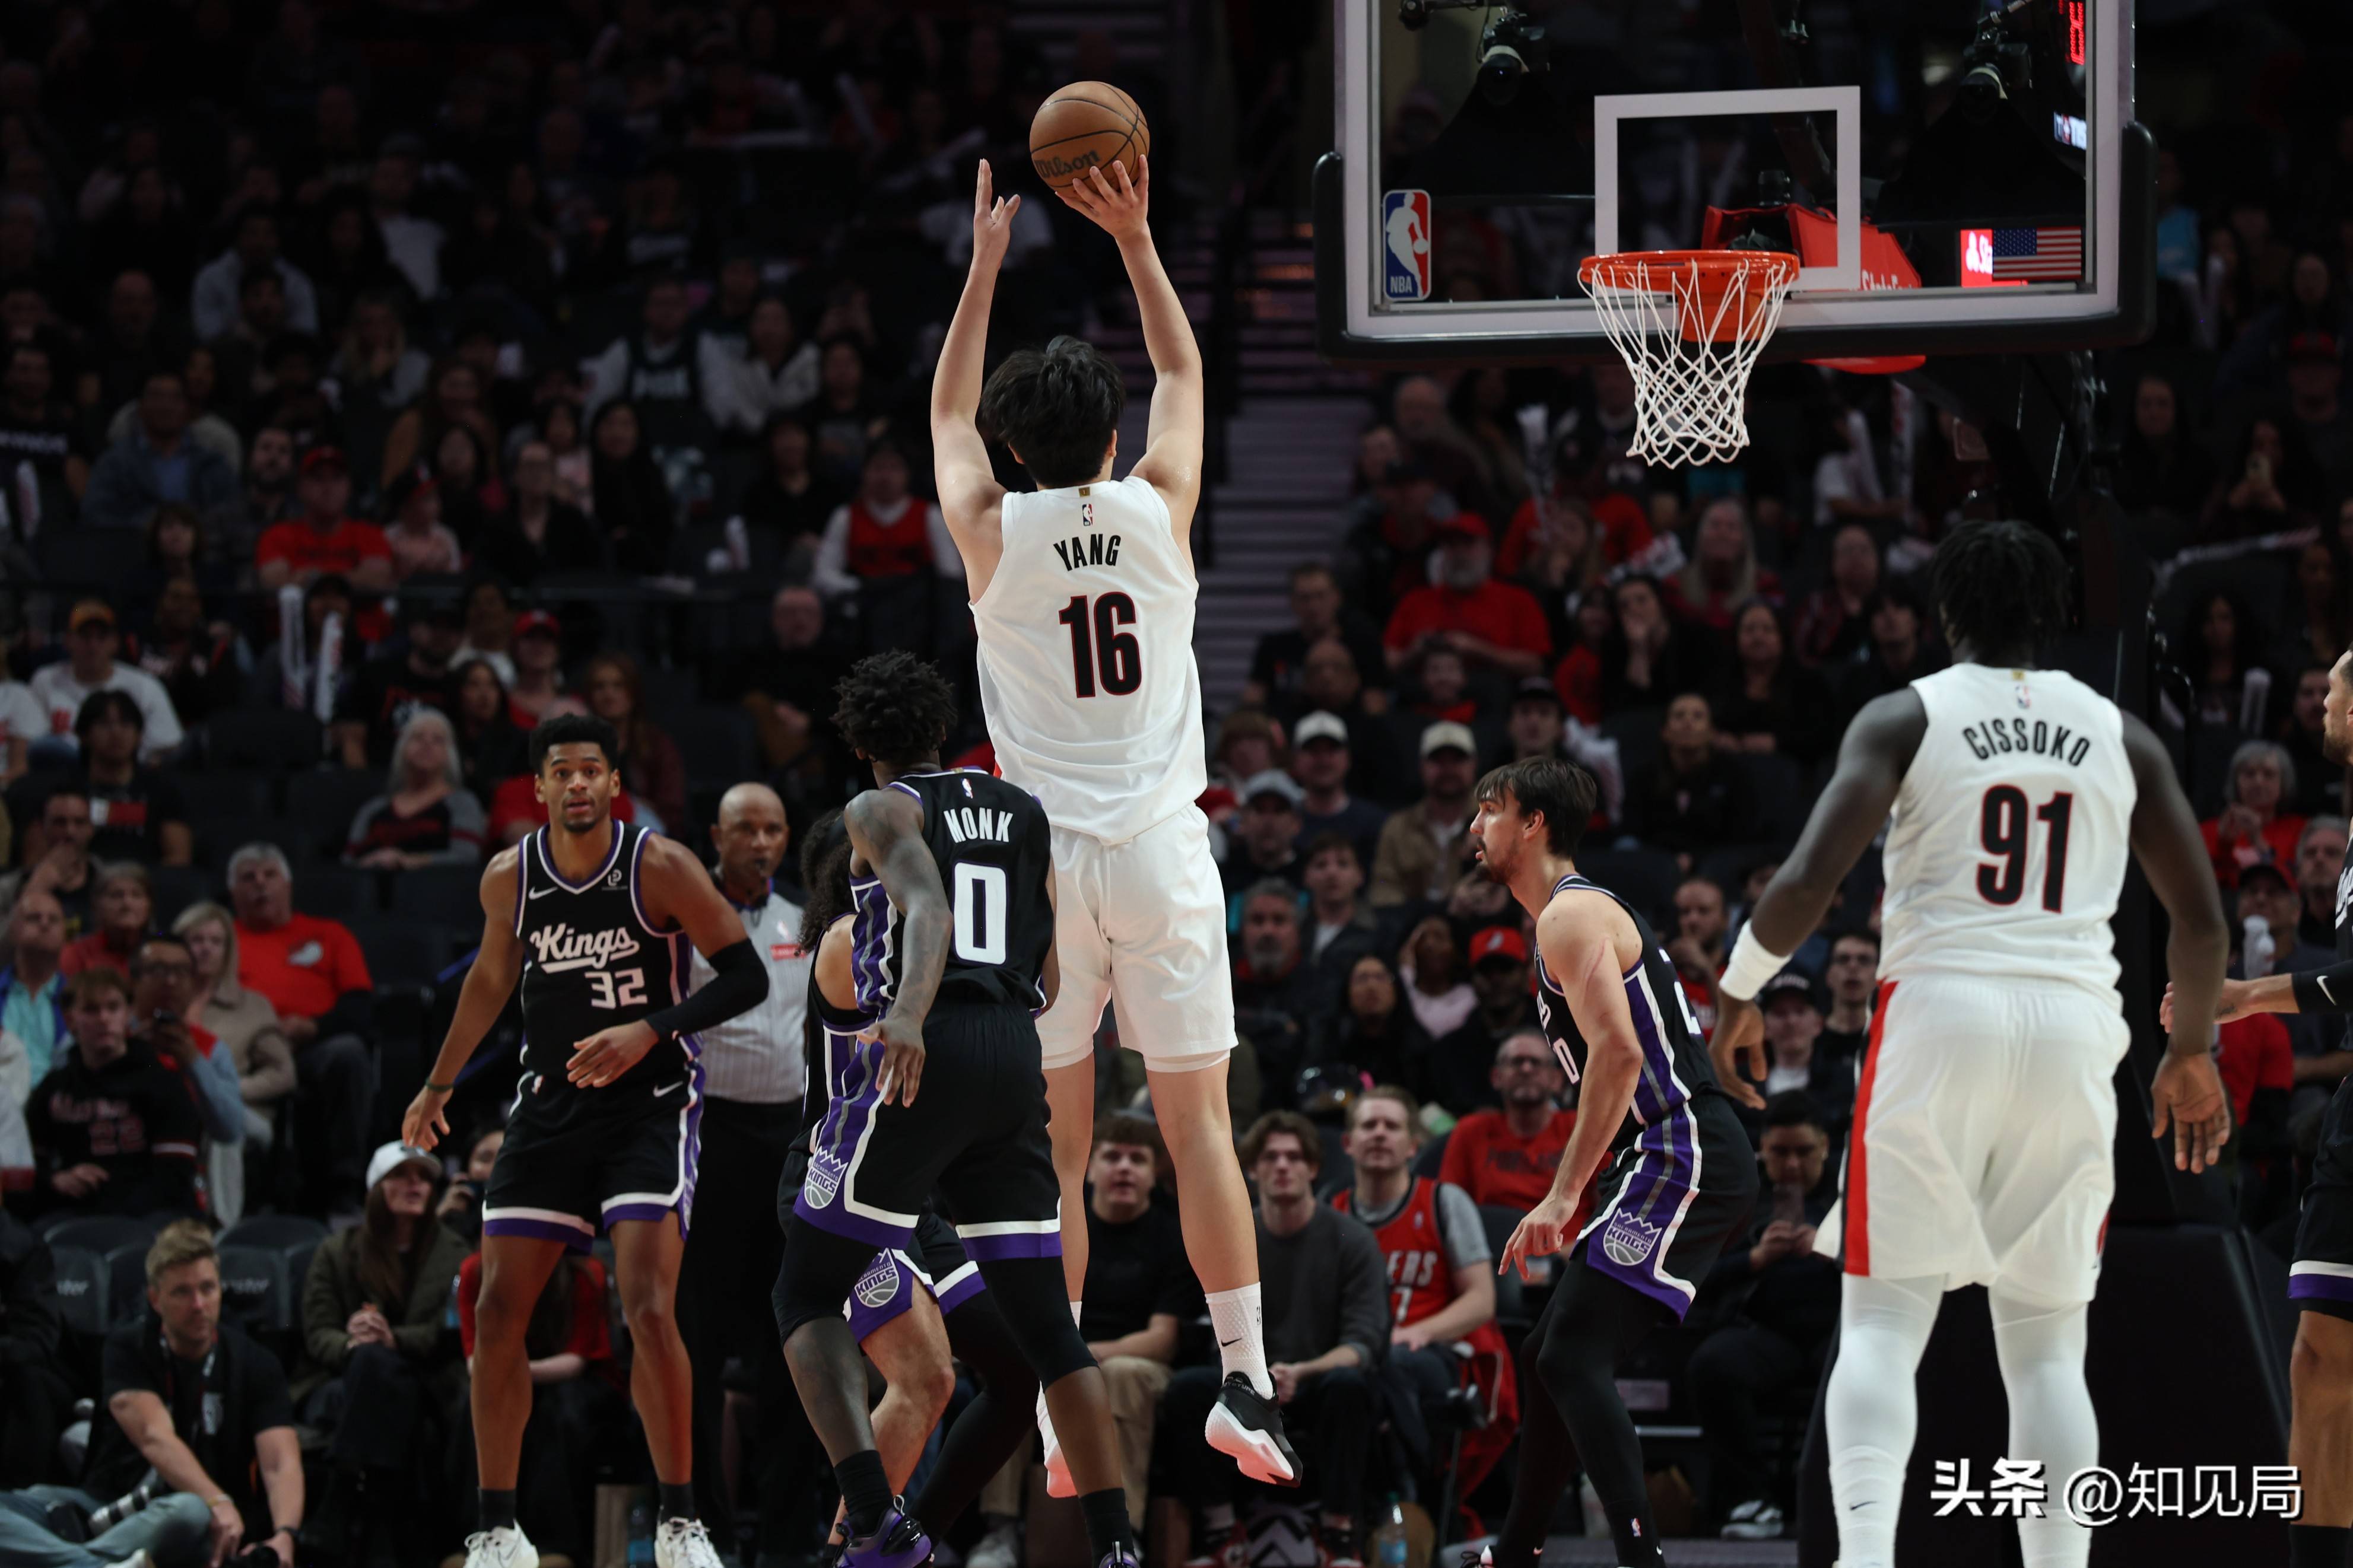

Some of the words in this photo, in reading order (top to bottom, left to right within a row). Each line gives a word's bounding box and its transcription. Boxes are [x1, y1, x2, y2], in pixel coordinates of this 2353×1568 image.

[1035, 150, 1100, 178] Wilson
[1390, 275, 1412, 294] NBA
[1053, 534, 1121, 571] YANG
[1059, 591, 1142, 698] 16
[1963, 718, 2090, 767] CISSOKO
[944, 807, 1013, 843] MONK
[1977, 784, 2073, 914] 91
[953, 860, 1008, 967] 0
[530, 923, 640, 974] Kings
[585, 967, 648, 1009] 32
[808, 1169, 837, 1194] KINGS
[1608, 1227, 1650, 1254] KINGS
[856, 1267, 896, 1295] KINGS
